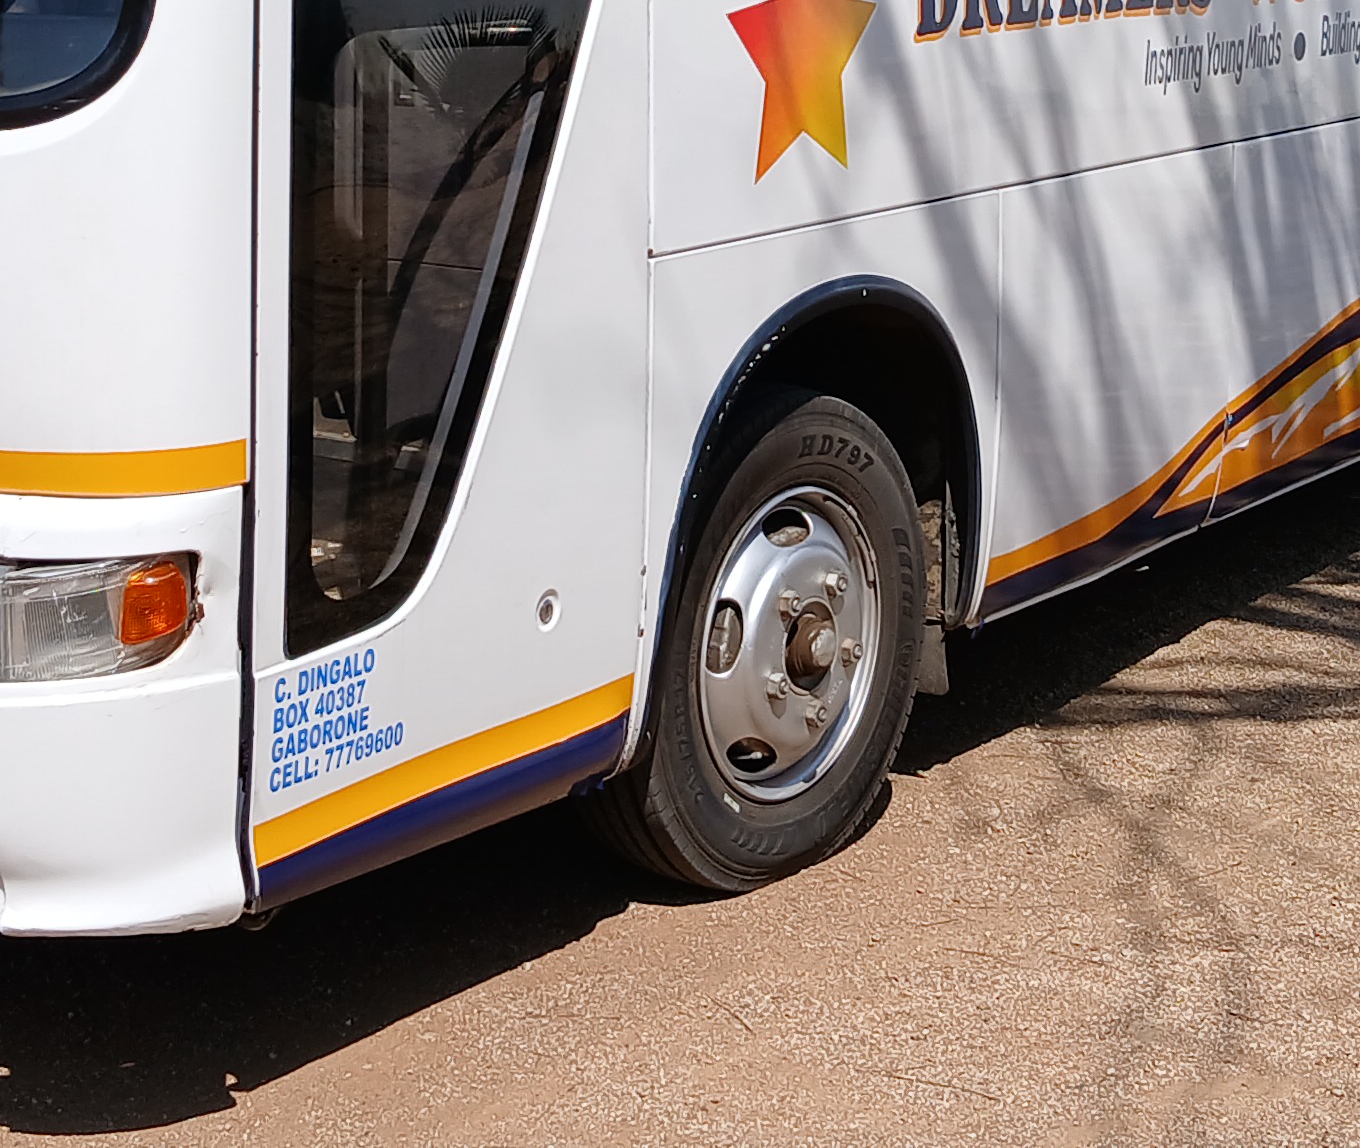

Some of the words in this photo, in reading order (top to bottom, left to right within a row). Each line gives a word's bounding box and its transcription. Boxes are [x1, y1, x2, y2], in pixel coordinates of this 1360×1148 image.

[1144, 34, 1204, 95] Inspiring
[1206, 30, 1246, 85] Young
[1245, 22, 1282, 70] Minds
[797, 433, 875, 473] HD797
[274, 677, 292, 704] C.
[297, 648, 375, 696] DINGALO
[271, 706, 370, 763] GABORONE
[273, 697, 310, 734] BOX
[314, 679, 366, 718] 40387
[269, 756, 319, 793] CELL:
[325, 721, 404, 774] 77769600
